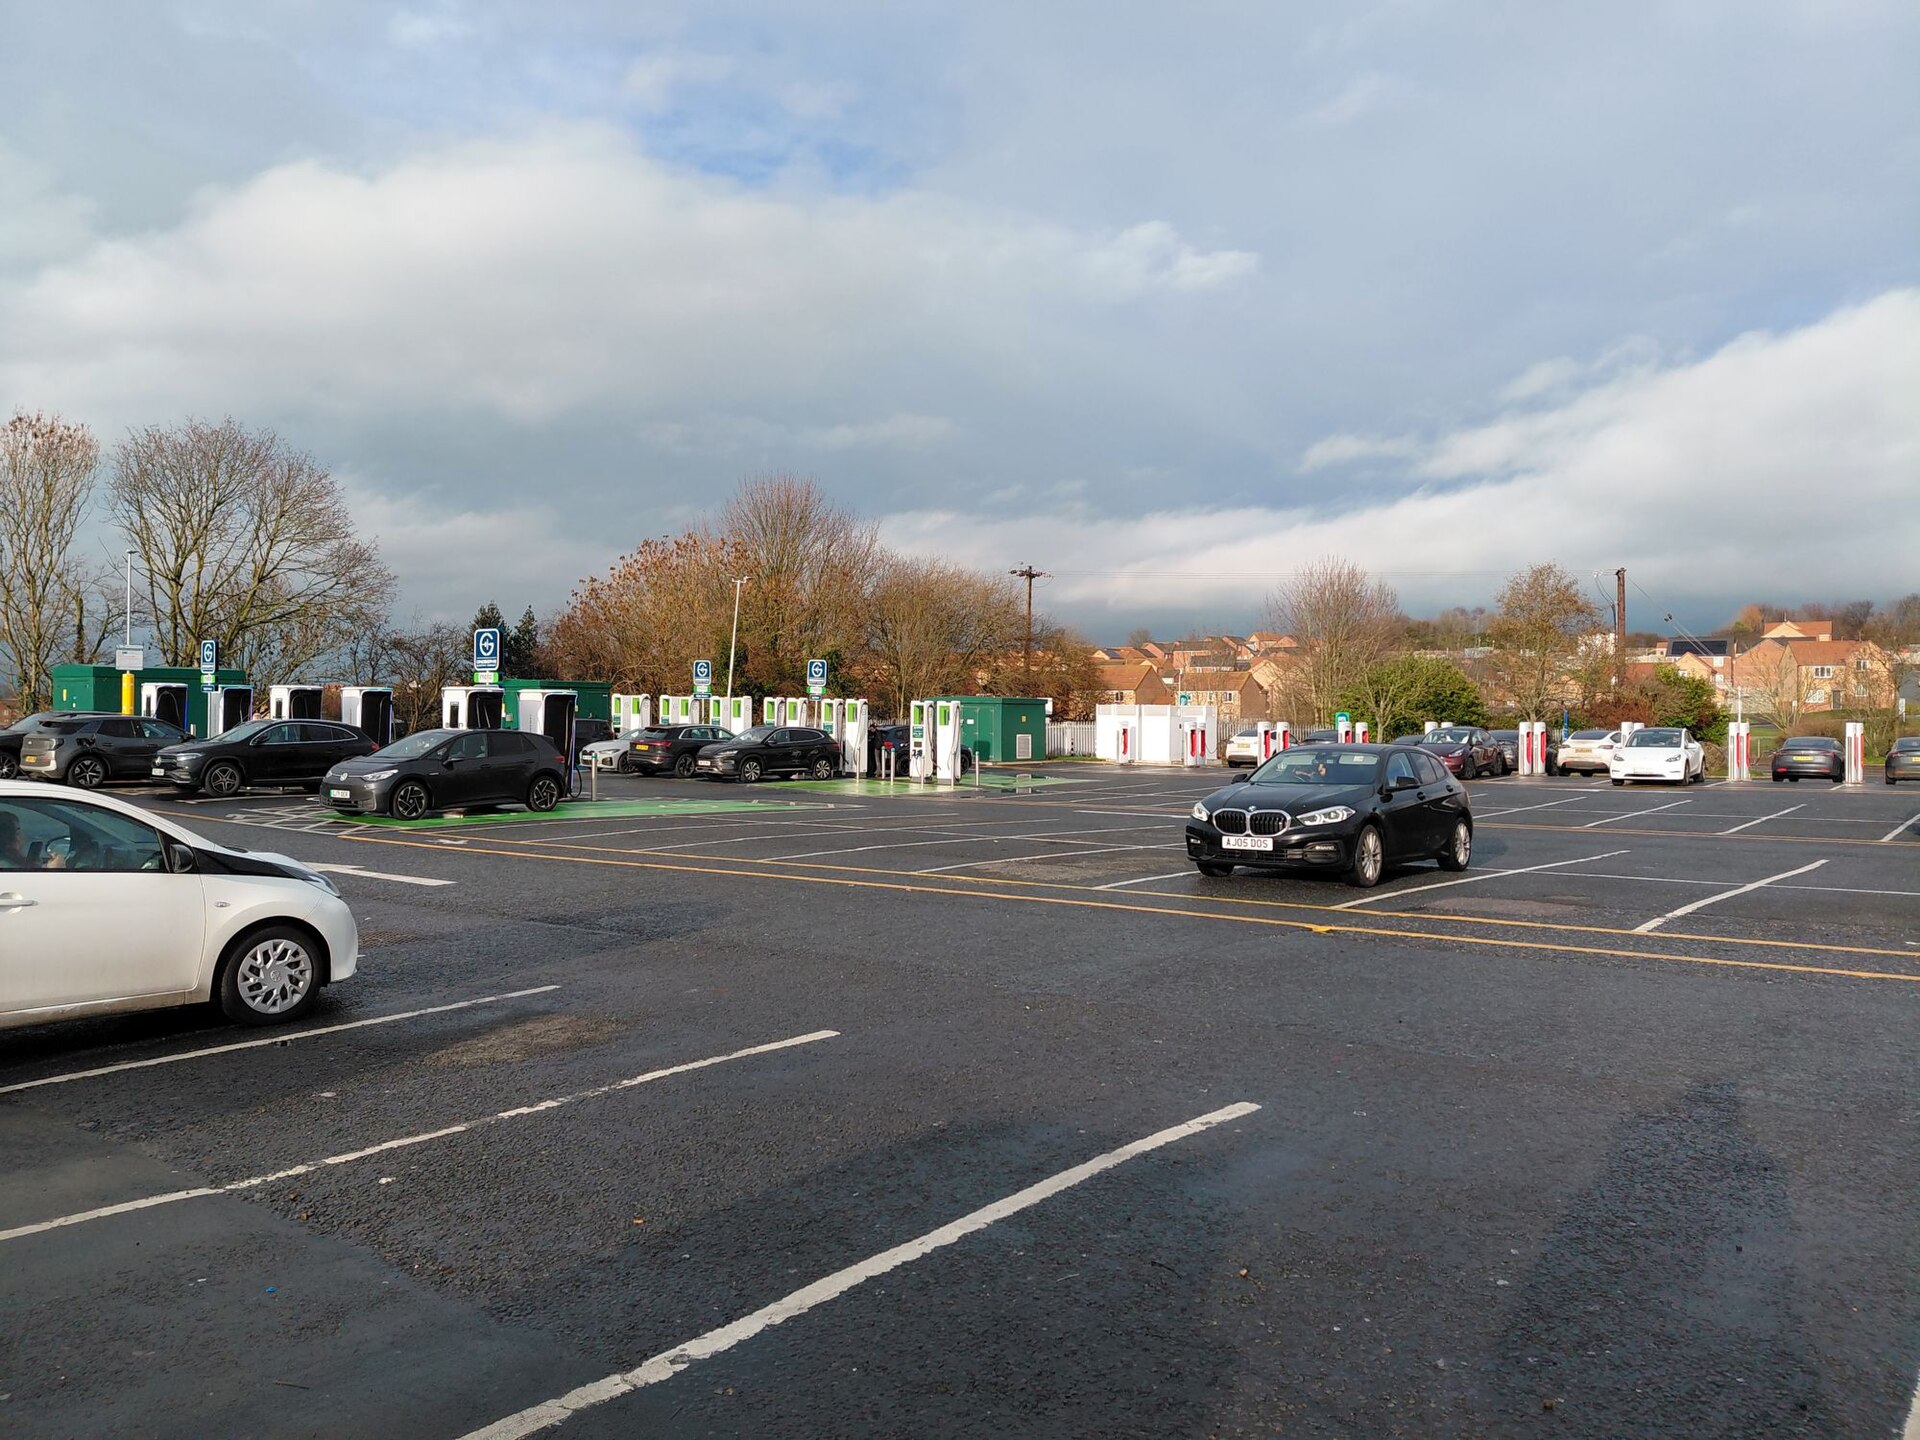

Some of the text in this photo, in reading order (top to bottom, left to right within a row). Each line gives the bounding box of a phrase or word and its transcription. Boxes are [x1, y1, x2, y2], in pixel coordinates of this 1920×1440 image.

[479, 632, 495, 657] G
[1226, 837, 1269, 849] AJ05 DOS
